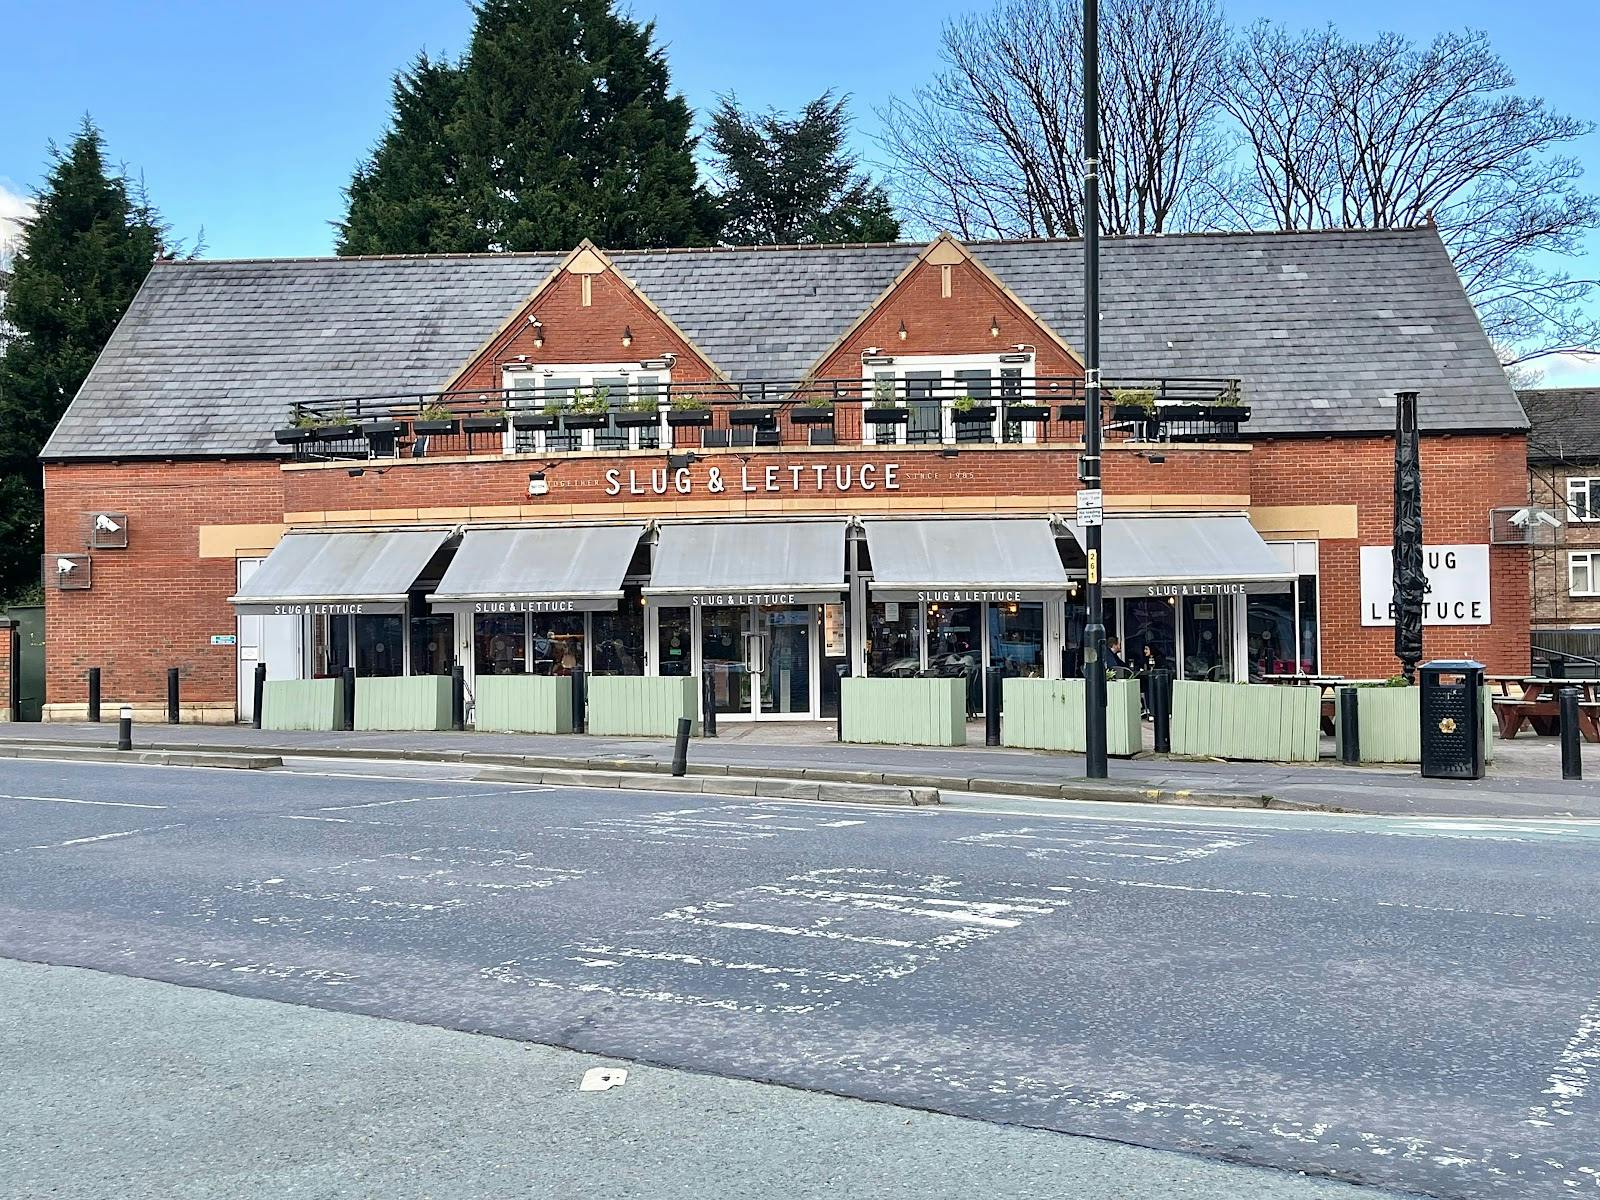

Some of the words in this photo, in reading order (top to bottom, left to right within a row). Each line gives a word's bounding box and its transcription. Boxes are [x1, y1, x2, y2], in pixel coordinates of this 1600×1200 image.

[605, 467, 691, 495] SLUG
[708, 469, 725, 493] &
[741, 463, 900, 492] LETTUCE
[905, 472, 939, 480] SINCE
[918, 591, 950, 601] SLUG
[954, 591, 961, 601] &
[965, 591, 1021, 601] LETTUCE
[1148, 585, 1178, 596] SLUG
[1182, 585, 1188, 595] &
[1193, 584, 1245, 595] LETTUCE
[692, 595, 723, 606] SLUG
[728, 595, 735, 605] &
[739, 594, 795, 605] LETTUCE
[274, 604, 302, 615] SLUG
[304, 604, 311, 614] &
[314, 603, 363, 614] LETTUCE
[475, 602, 506, 613] SLUG
[509, 602, 517, 612] &
[520, 600, 575, 612] LETTUCE
[1372, 601, 1481, 620] LETUCE
